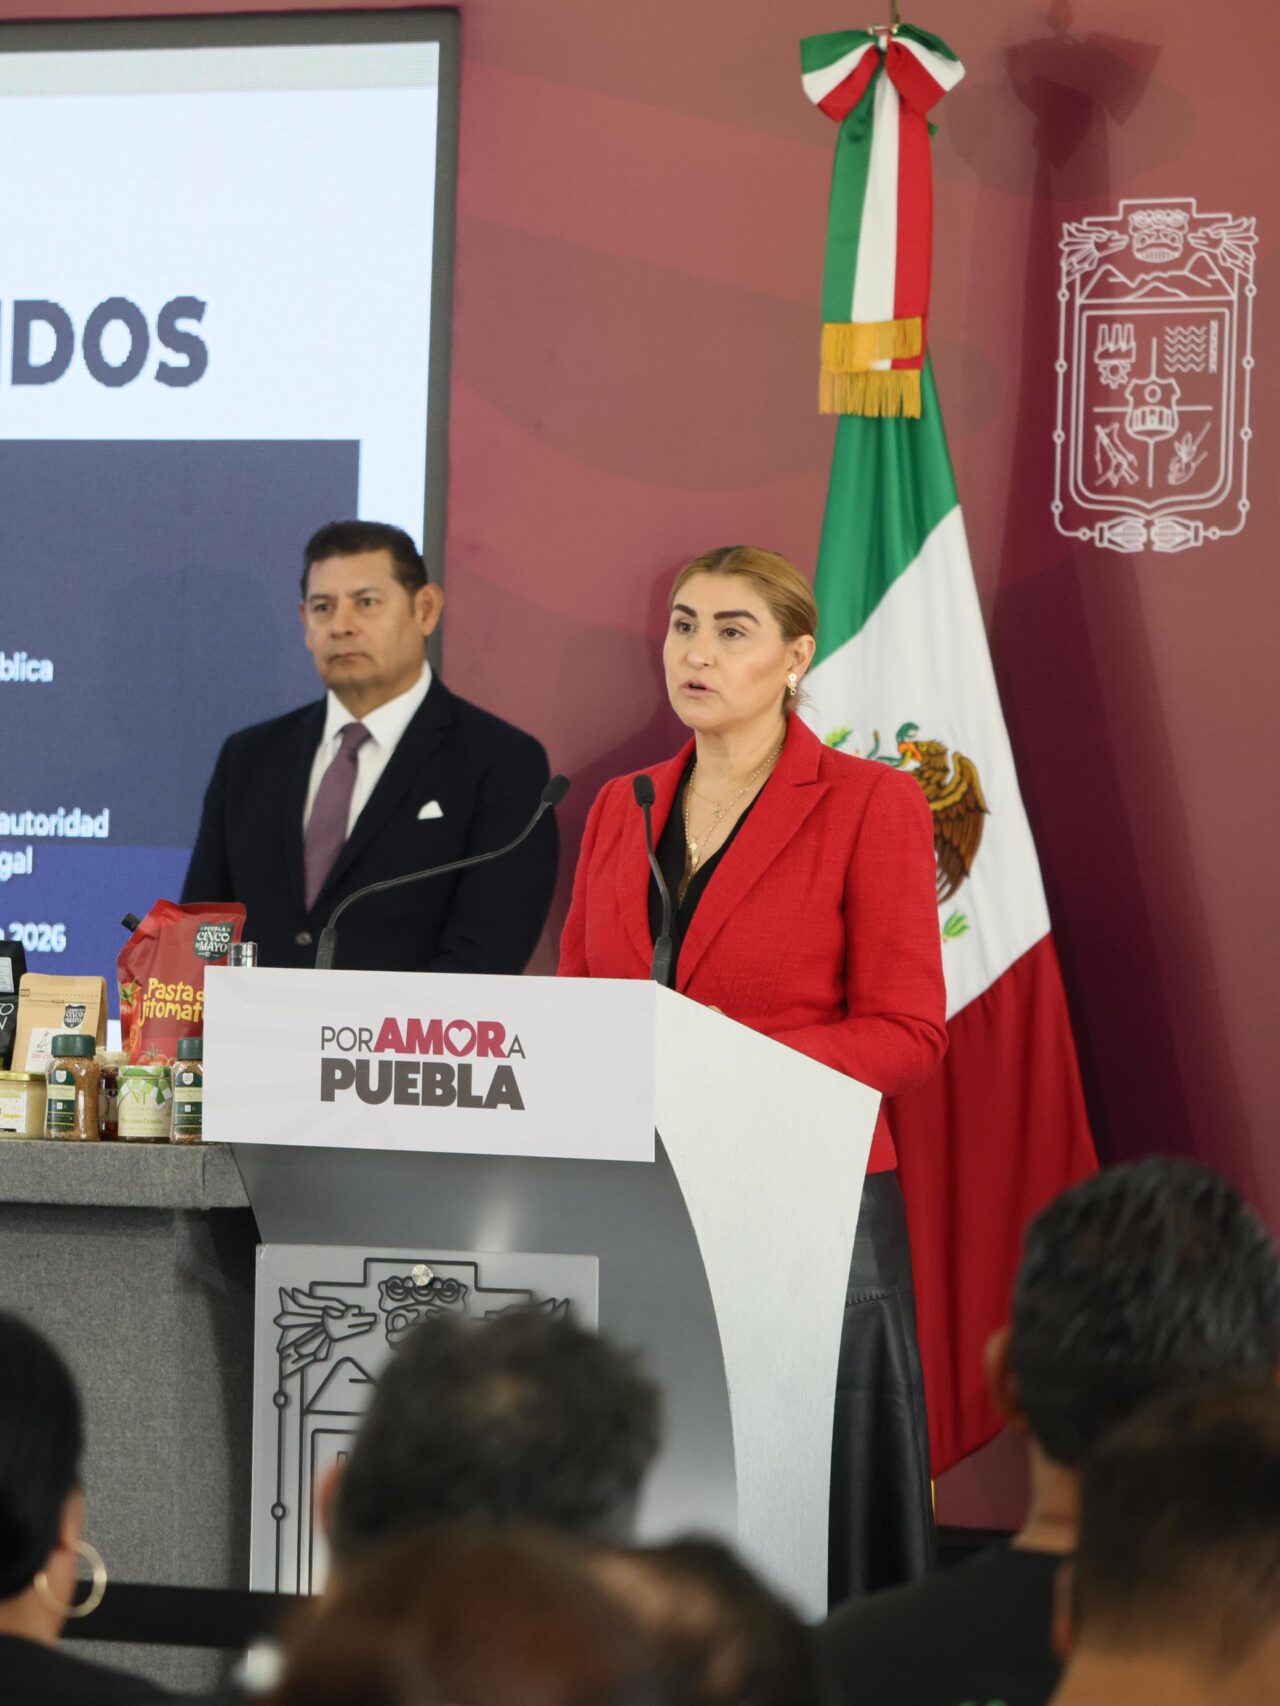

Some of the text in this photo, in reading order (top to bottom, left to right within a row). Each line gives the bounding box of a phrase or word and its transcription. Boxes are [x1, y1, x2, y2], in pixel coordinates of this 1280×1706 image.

[9, 922, 66, 952] 2026
[196, 931, 230, 942] CINCO
[198, 941, 228, 953] MAYO
[147, 977, 194, 1001] Pasta
[138, 997, 203, 1028] jitomat
[320, 1017, 526, 1059] POR AMOR A
[320, 1057, 526, 1111] PUEBLA
